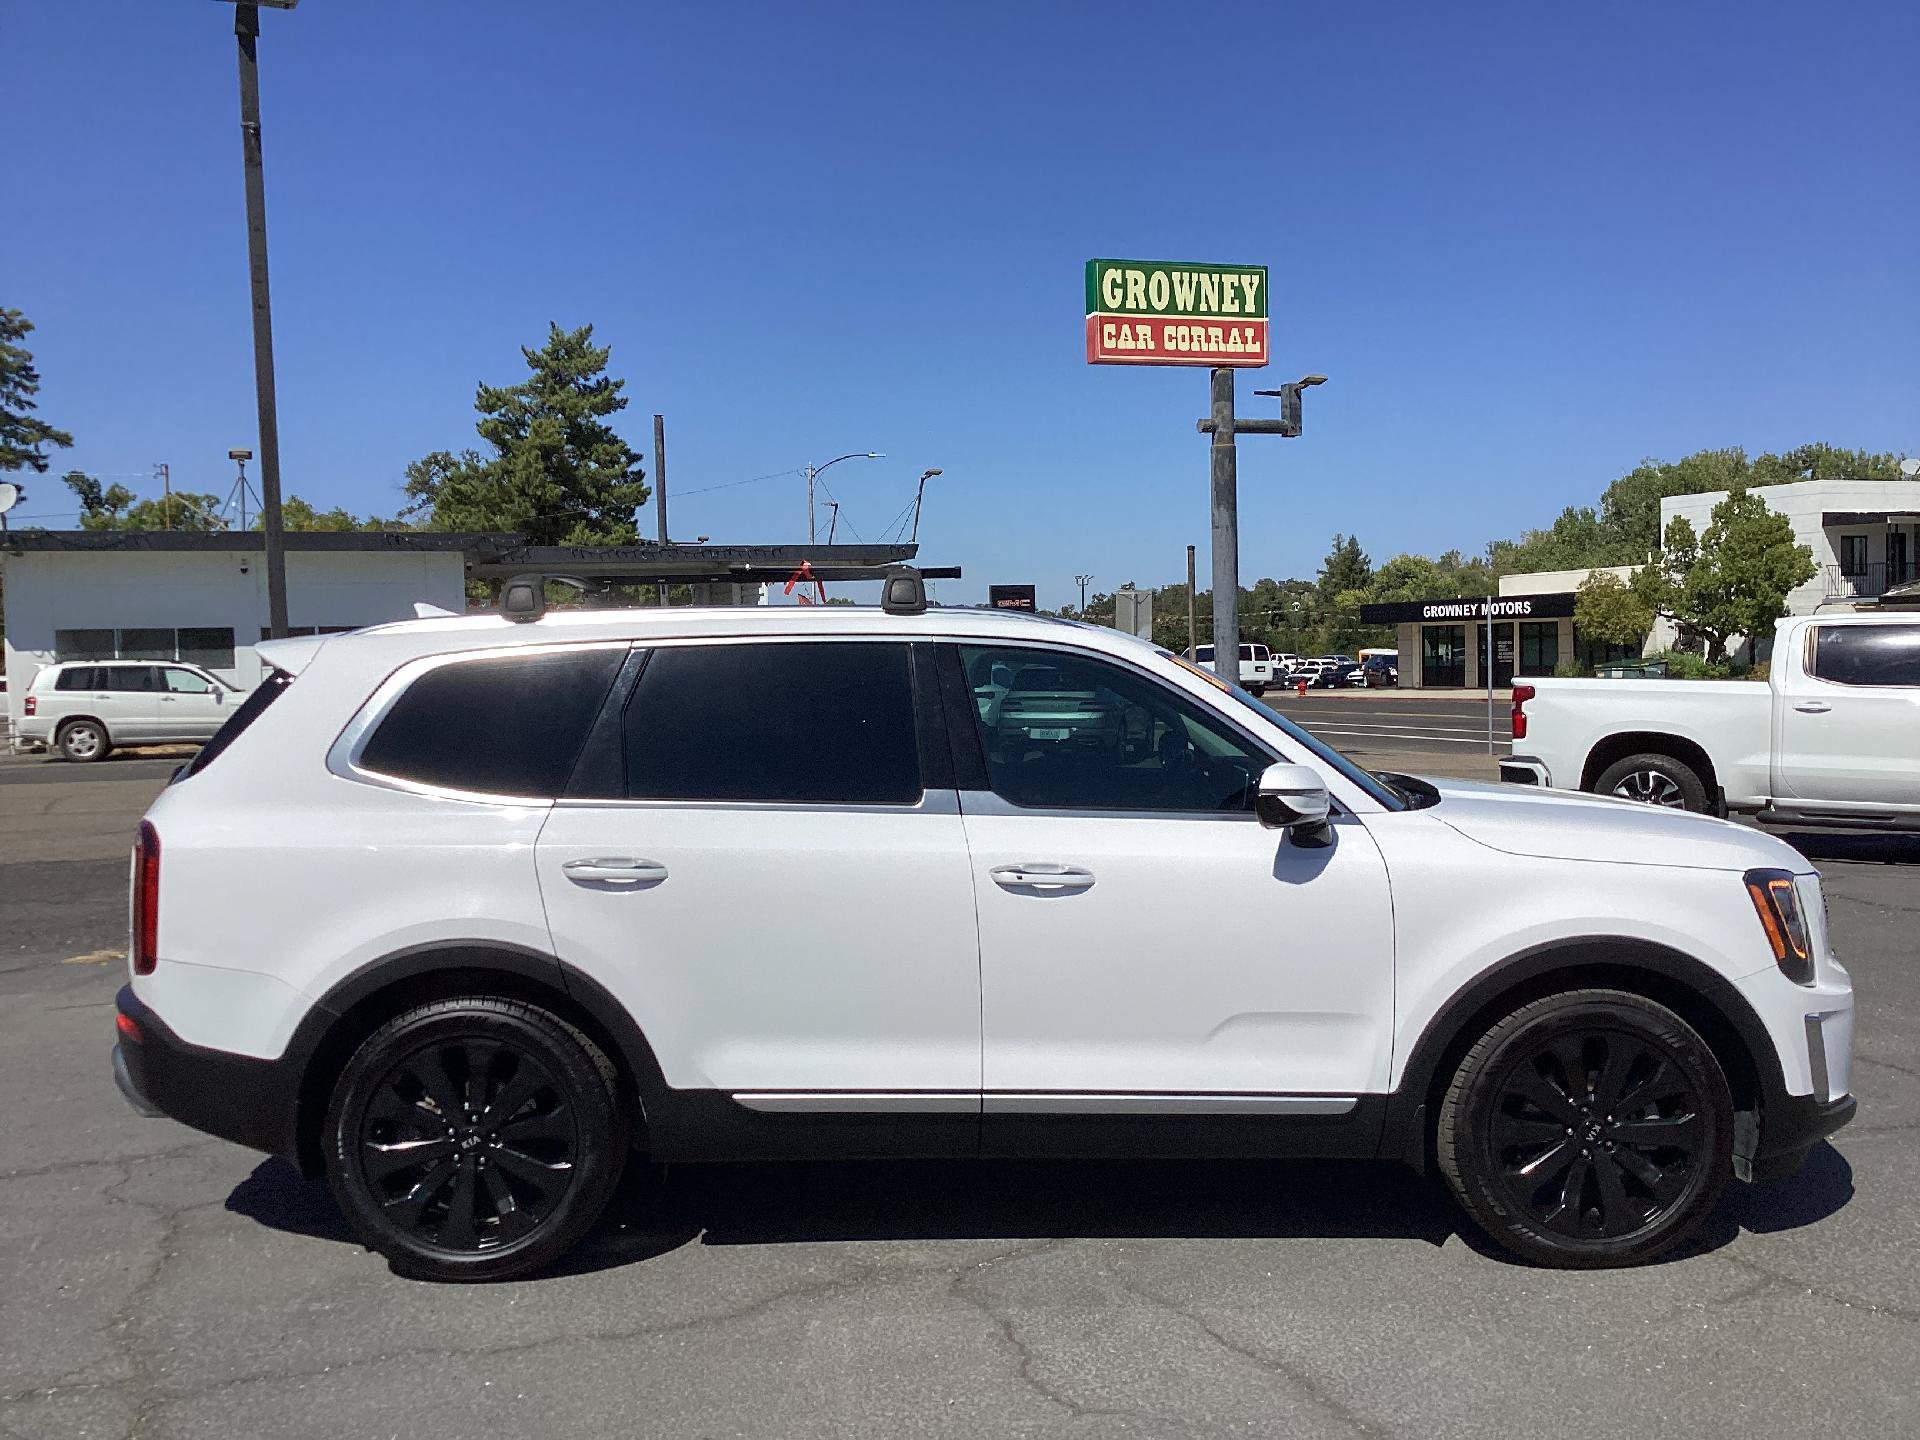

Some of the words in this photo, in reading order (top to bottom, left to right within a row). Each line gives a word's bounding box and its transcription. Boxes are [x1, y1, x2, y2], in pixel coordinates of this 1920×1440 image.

[1102, 268, 1259, 312] GROWNEY
[1103, 323, 1155, 350] CAR
[1163, 325, 1261, 353] CORRAL
[1423, 603, 1478, 618] GROWNEY
